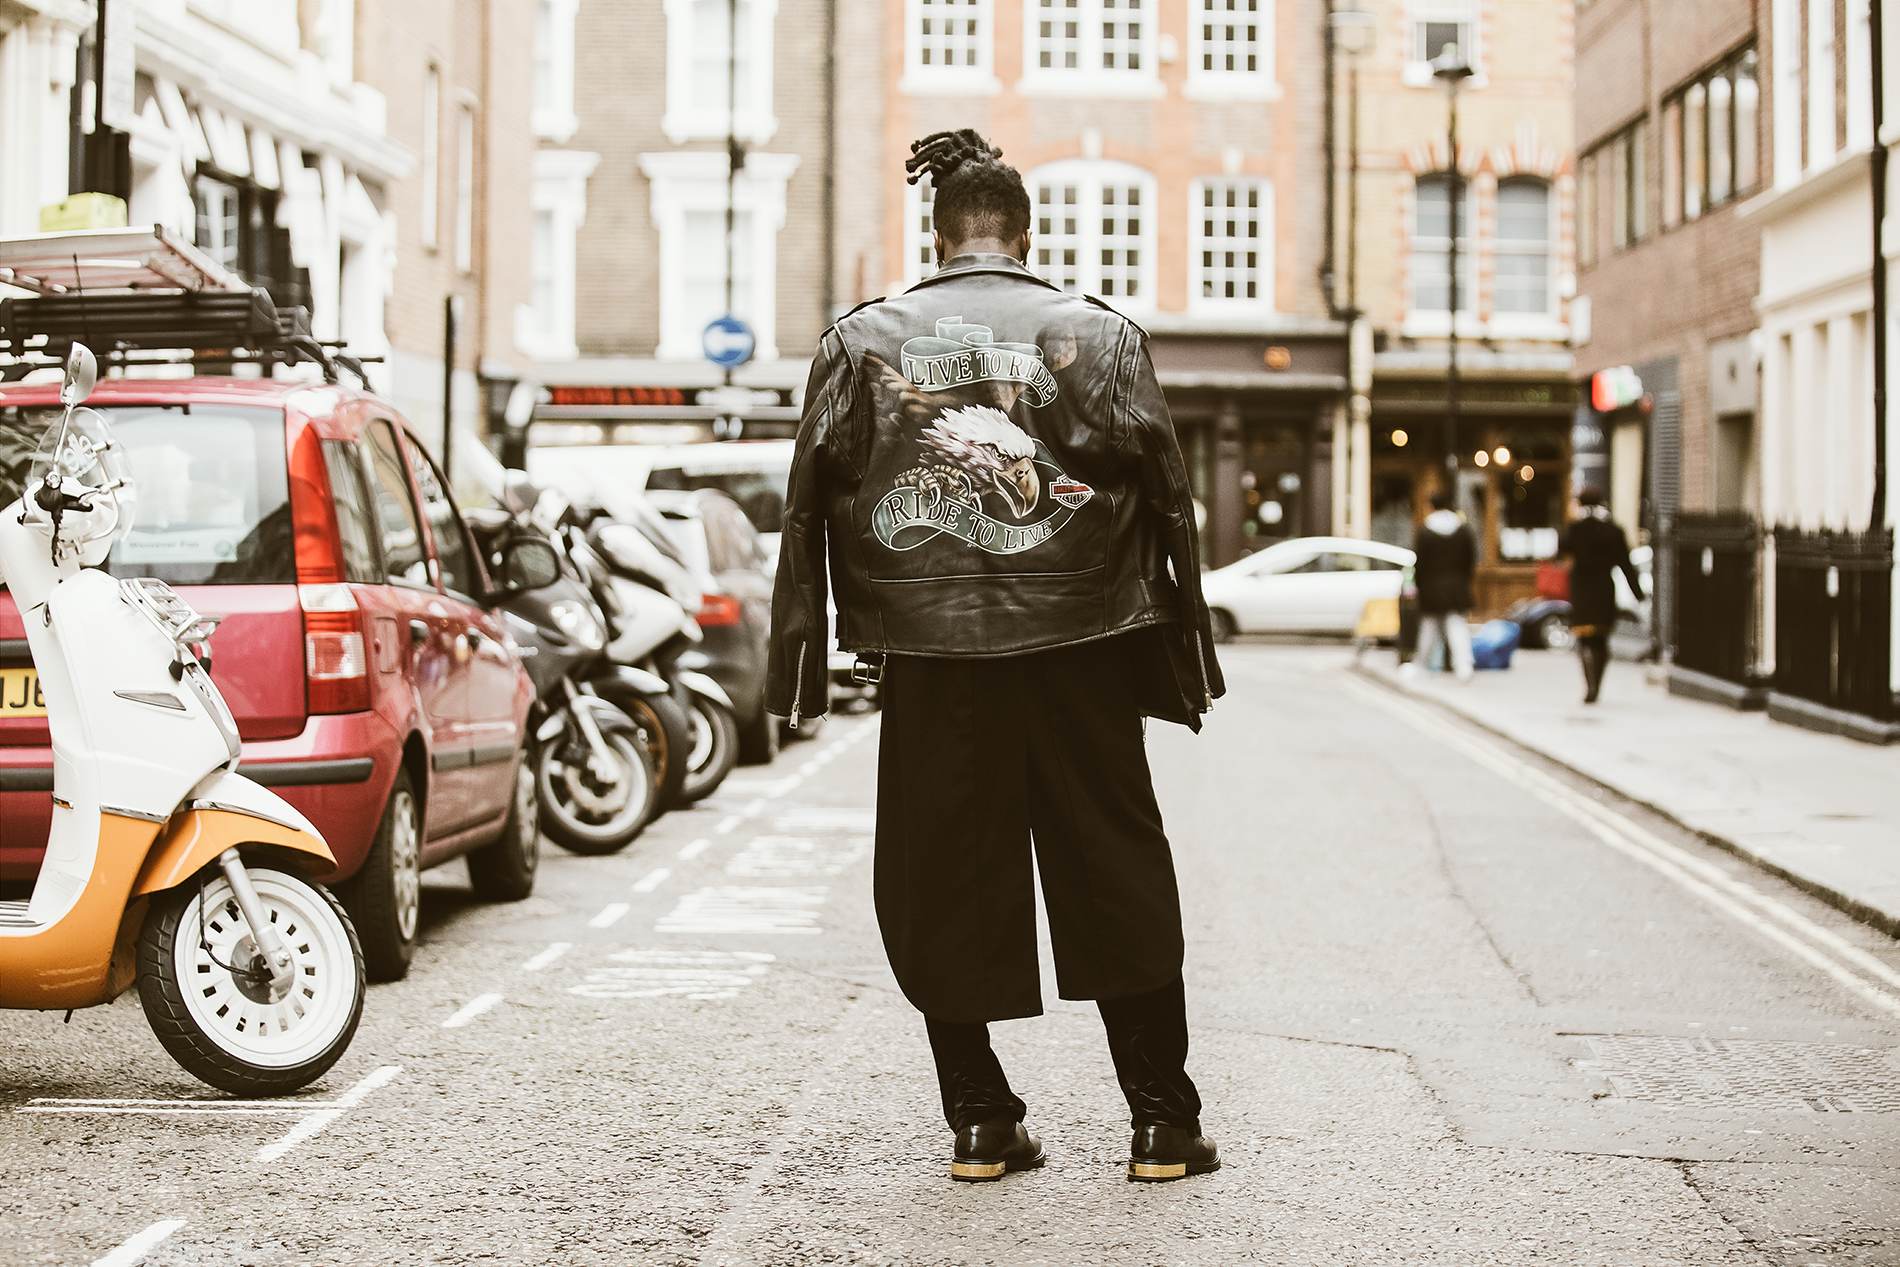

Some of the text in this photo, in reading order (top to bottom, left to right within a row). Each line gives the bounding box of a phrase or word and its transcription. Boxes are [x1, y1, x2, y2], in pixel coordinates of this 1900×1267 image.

[906, 351, 1056, 400] LIVE TO RIDE
[885, 491, 1052, 550] RIDE TO LIVE
